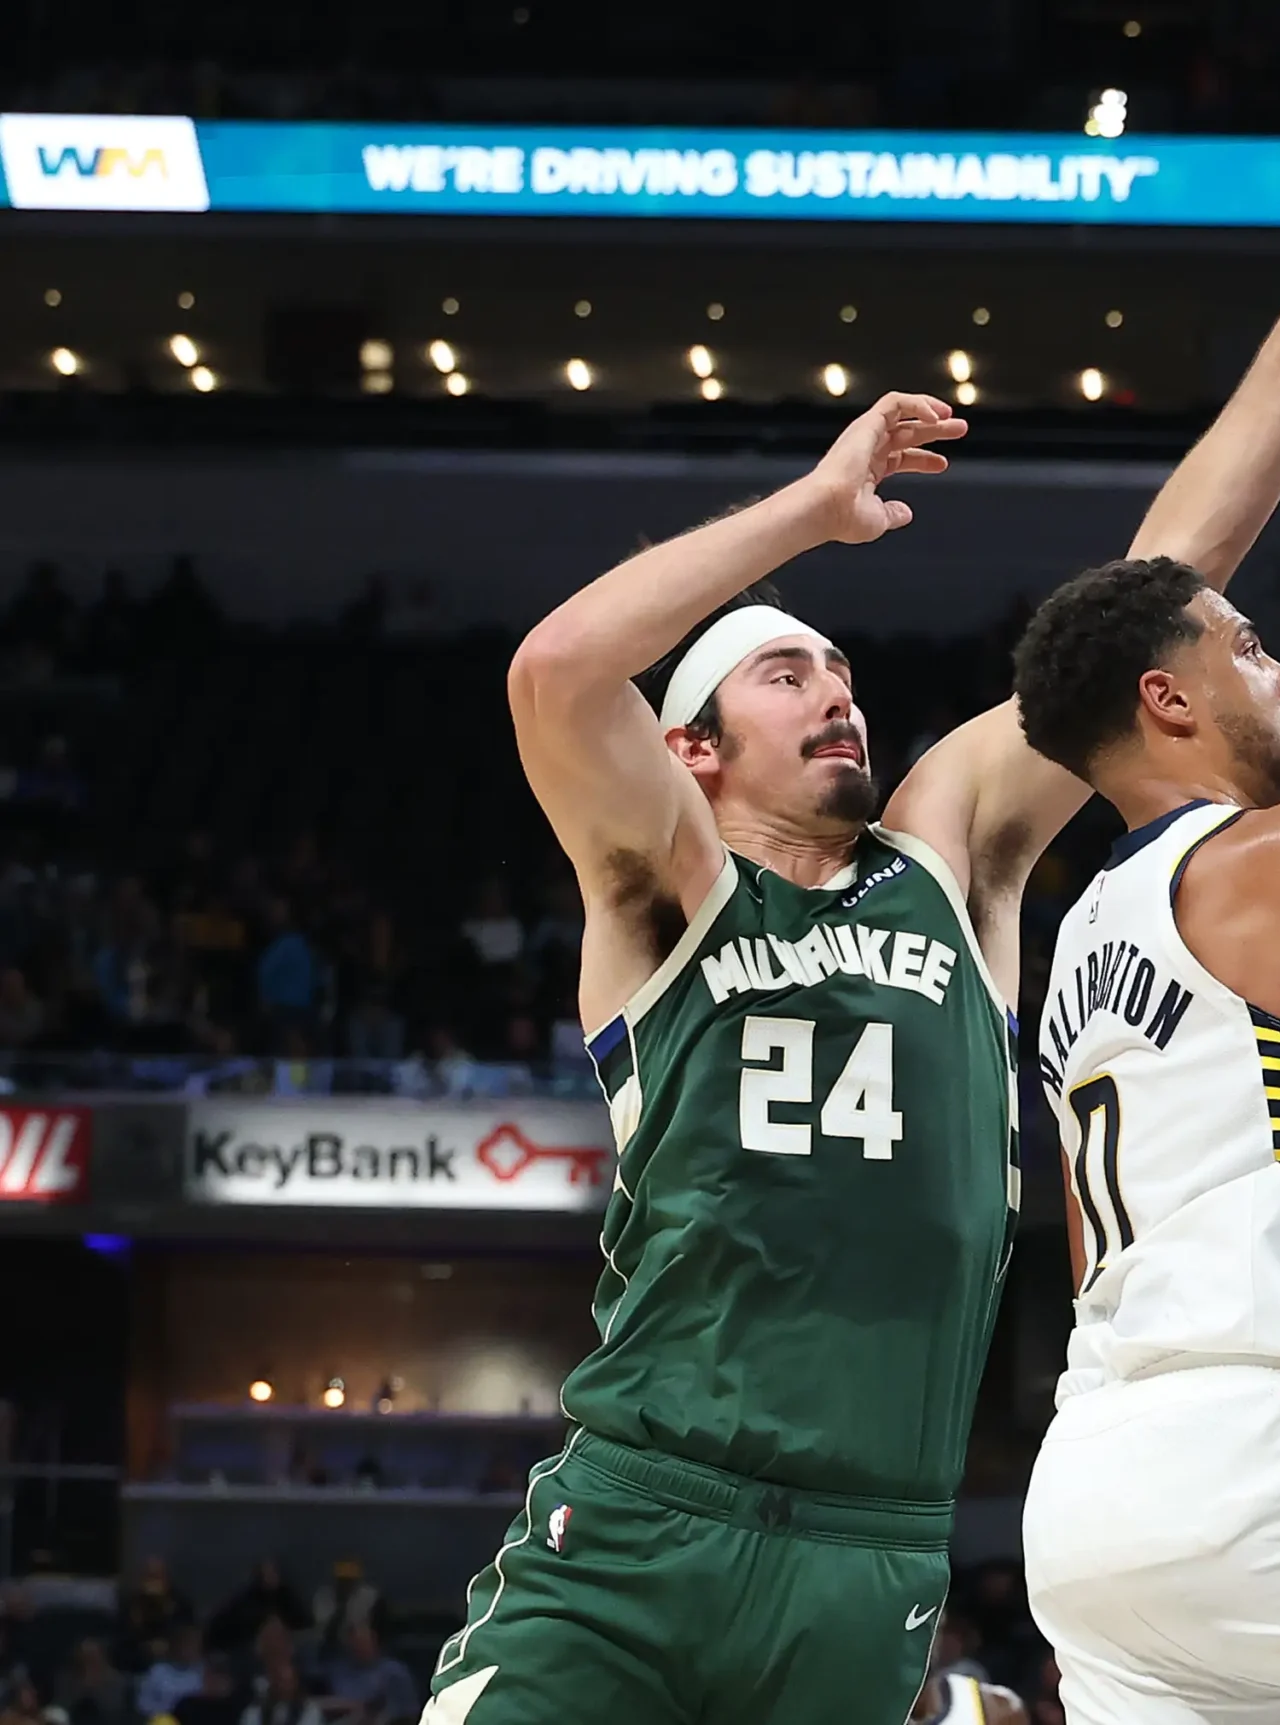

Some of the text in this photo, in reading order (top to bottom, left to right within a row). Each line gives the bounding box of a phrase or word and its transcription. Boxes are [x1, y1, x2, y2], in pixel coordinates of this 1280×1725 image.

[37, 147, 170, 179] WM
[362, 144, 524, 193] WE'RE
[531, 147, 738, 197] DRIVING
[700, 923, 958, 1006] MILWAUKEE
[739, 1015, 904, 1161] 24
[193, 1129, 457, 1189] KeyBank
